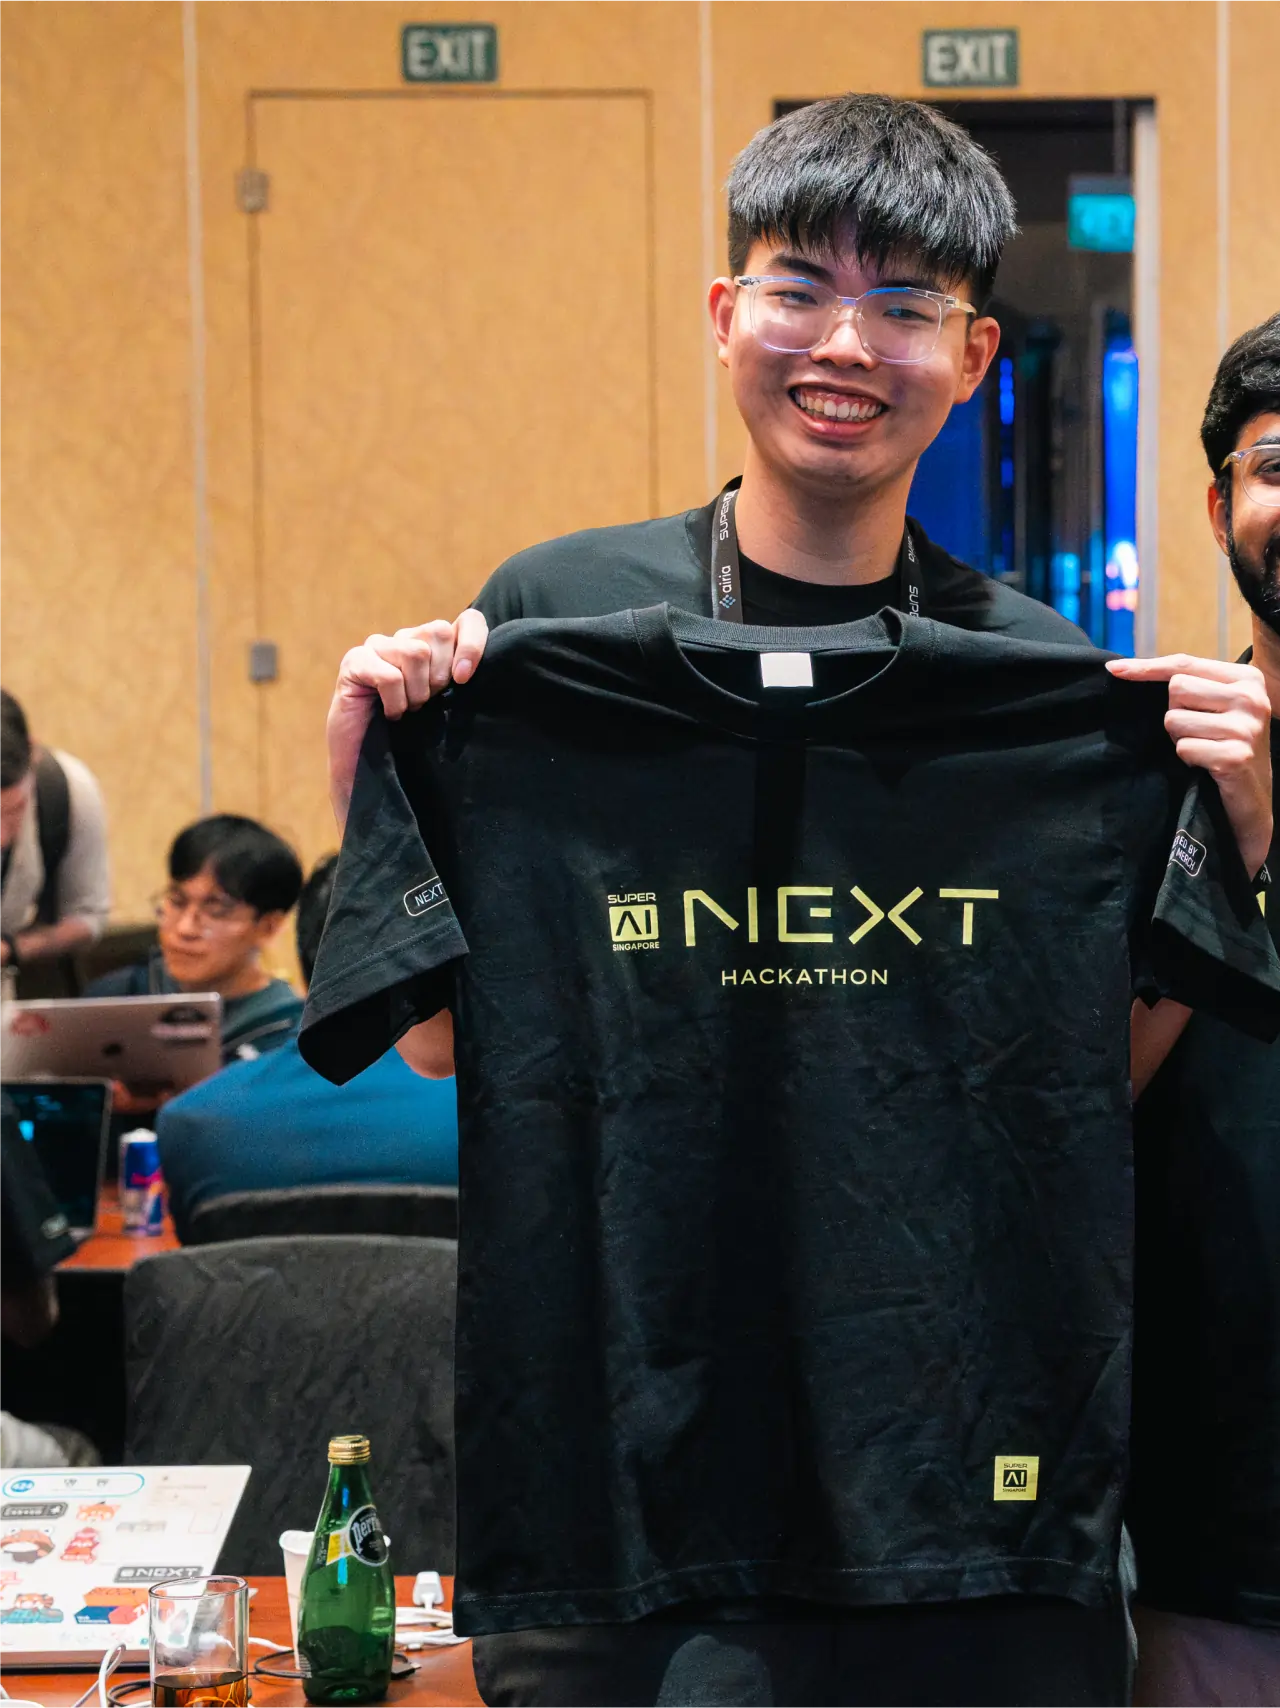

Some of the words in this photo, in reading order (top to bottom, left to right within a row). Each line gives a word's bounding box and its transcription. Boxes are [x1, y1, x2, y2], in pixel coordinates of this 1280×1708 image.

[407, 31, 489, 78] EXIT
[927, 35, 1011, 81] EXIT
[718, 565, 732, 593] airia
[1187, 844, 1198, 857] BY
[414, 882, 443, 907] NEXT
[607, 892, 657, 904] SUPER
[614, 908, 653, 938] AI
[683, 885, 1000, 947] NEXT
[612, 941, 660, 951] SINGAPORE
[721, 968, 888, 985] HACKATHON
[1004, 1470, 1026, 1486] AI
